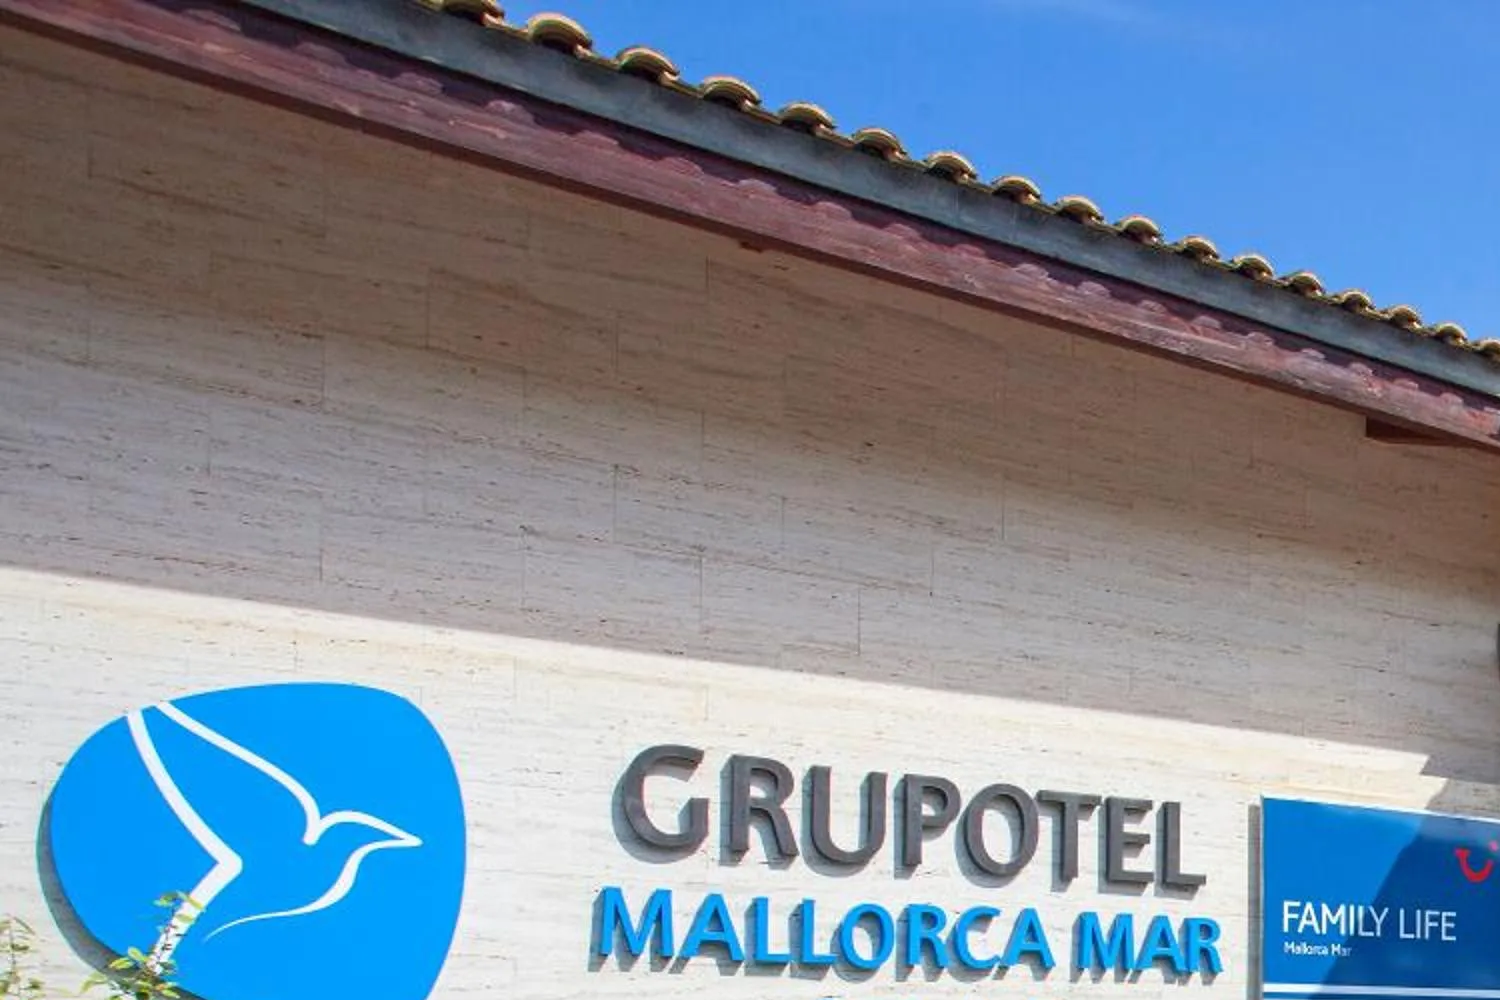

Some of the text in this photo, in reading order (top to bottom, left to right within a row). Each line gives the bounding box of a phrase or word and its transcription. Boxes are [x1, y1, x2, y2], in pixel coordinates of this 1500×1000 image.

[620, 744, 1207, 888] GRUPOTEL
[598, 886, 1223, 974] MALLORCA MAR
[1282, 900, 1457, 941] FAMILY LIFE
